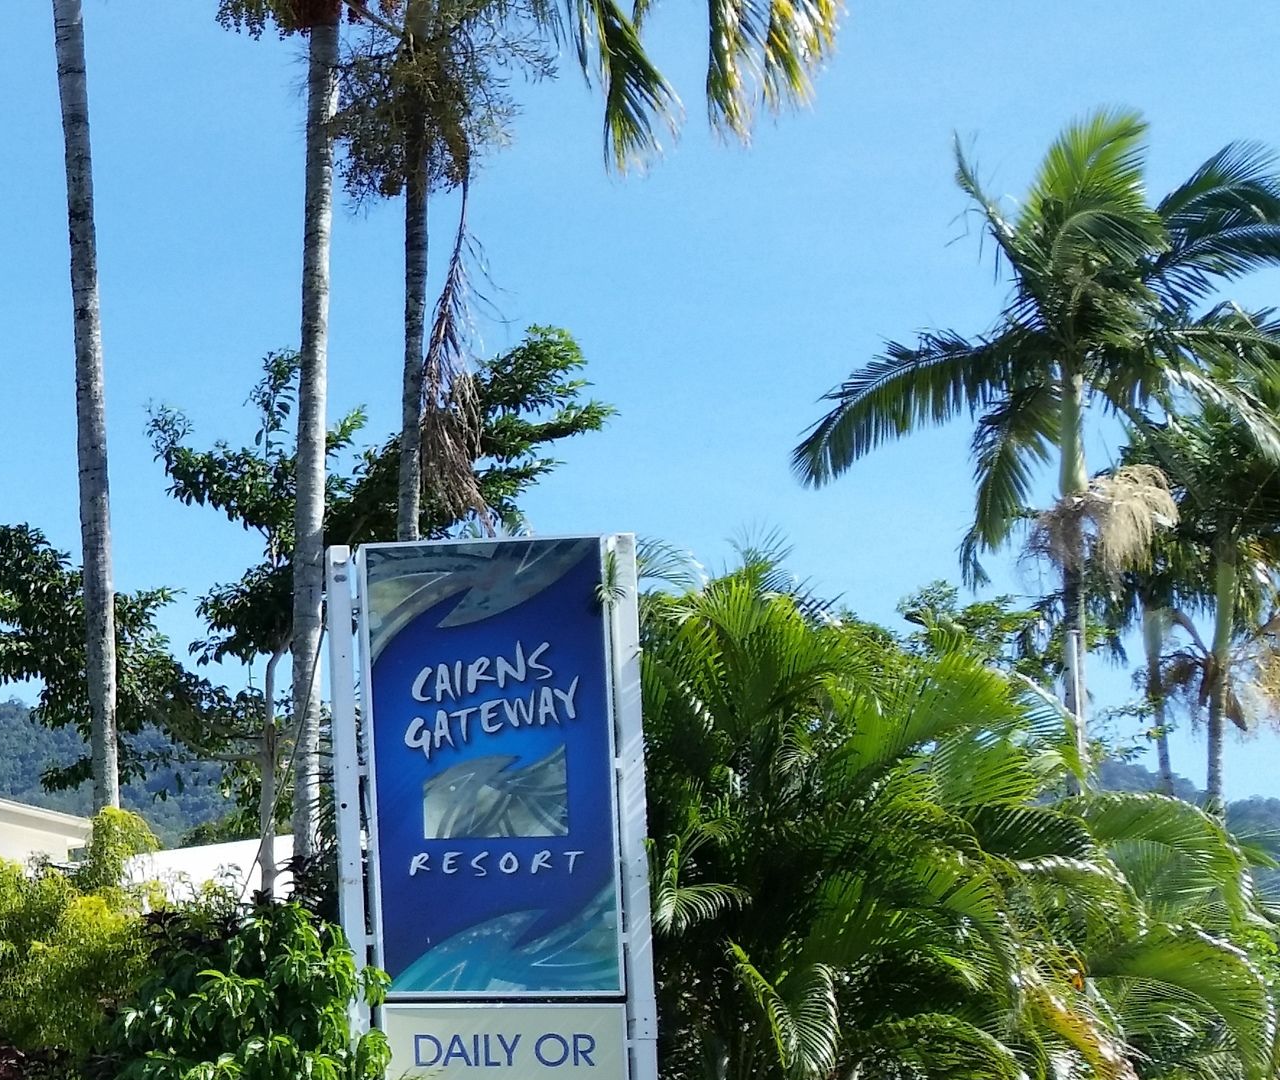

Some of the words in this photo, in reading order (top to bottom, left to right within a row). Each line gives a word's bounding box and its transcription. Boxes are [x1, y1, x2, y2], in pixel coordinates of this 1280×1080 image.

[411, 640, 553, 702] CAIRNS
[404, 675, 579, 760] GATEWAY
[409, 850, 585, 877] RESORT
[413, 1033, 522, 1068] DAILY
[534, 1033, 597, 1068] OR
